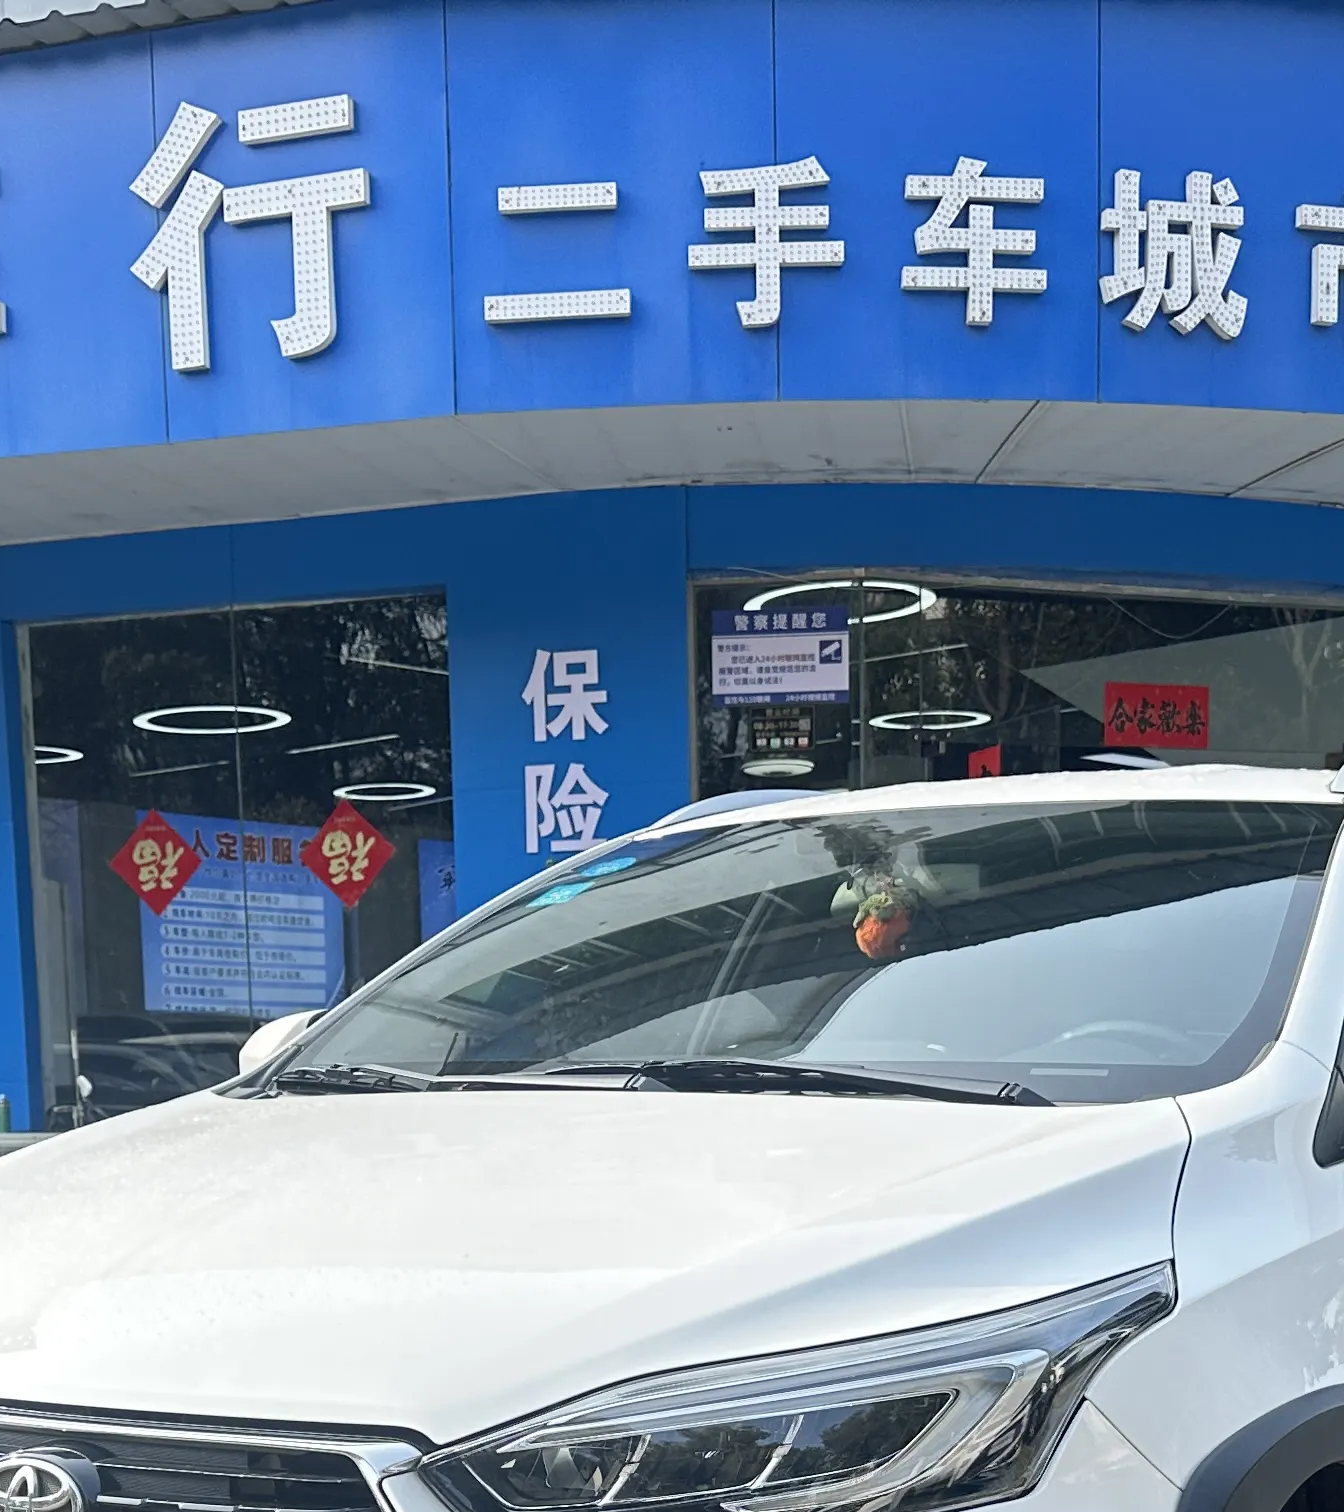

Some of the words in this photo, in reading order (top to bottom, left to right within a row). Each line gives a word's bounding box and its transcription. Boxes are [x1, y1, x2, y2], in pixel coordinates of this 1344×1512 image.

[733, 611, 828, 632] 警察提醒您
[521, 648, 610, 855] 保险
[132, 838, 184, 893] 福
[321, 829, 376, 885] 福
